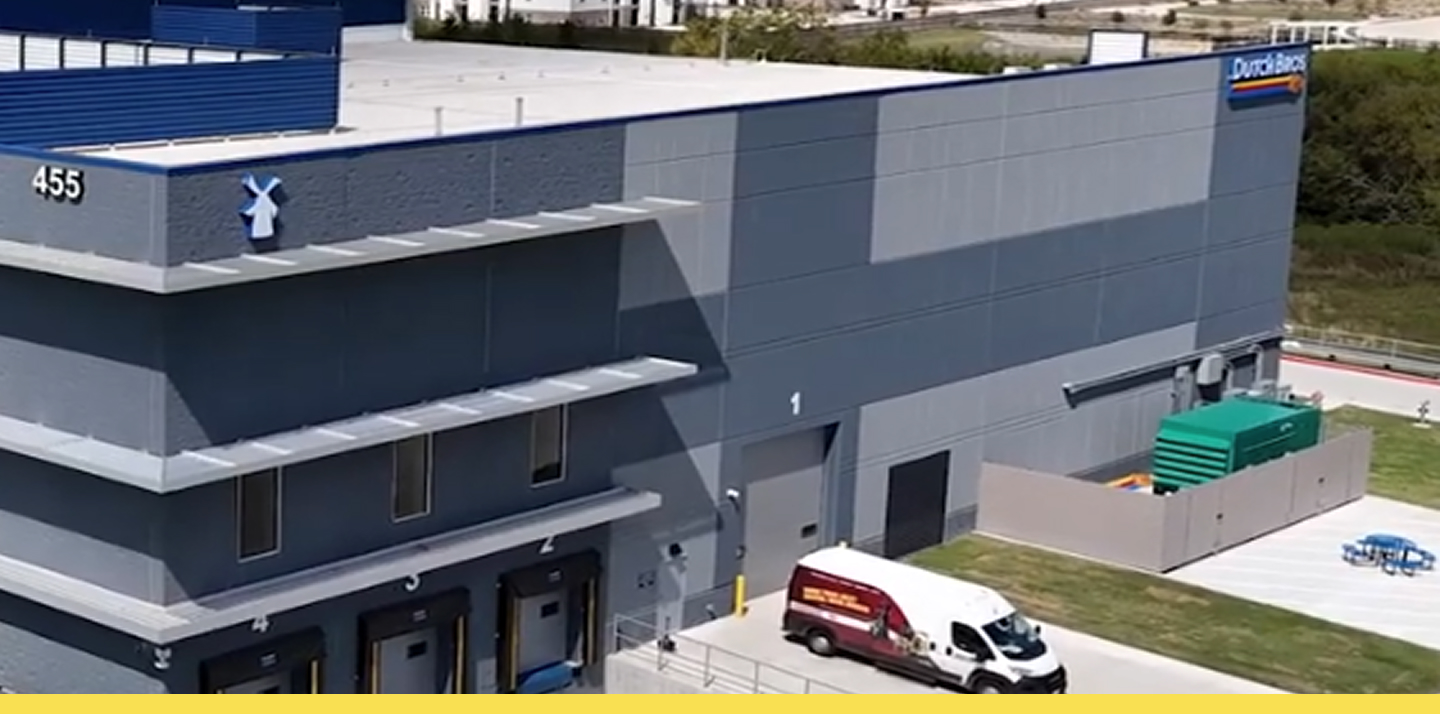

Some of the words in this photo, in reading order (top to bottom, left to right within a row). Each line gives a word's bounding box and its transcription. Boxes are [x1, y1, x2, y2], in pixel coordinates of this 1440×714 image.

[32, 164, 83, 200] 455
[790, 391, 801, 416] 1
[252, 614, 269, 632] 4
